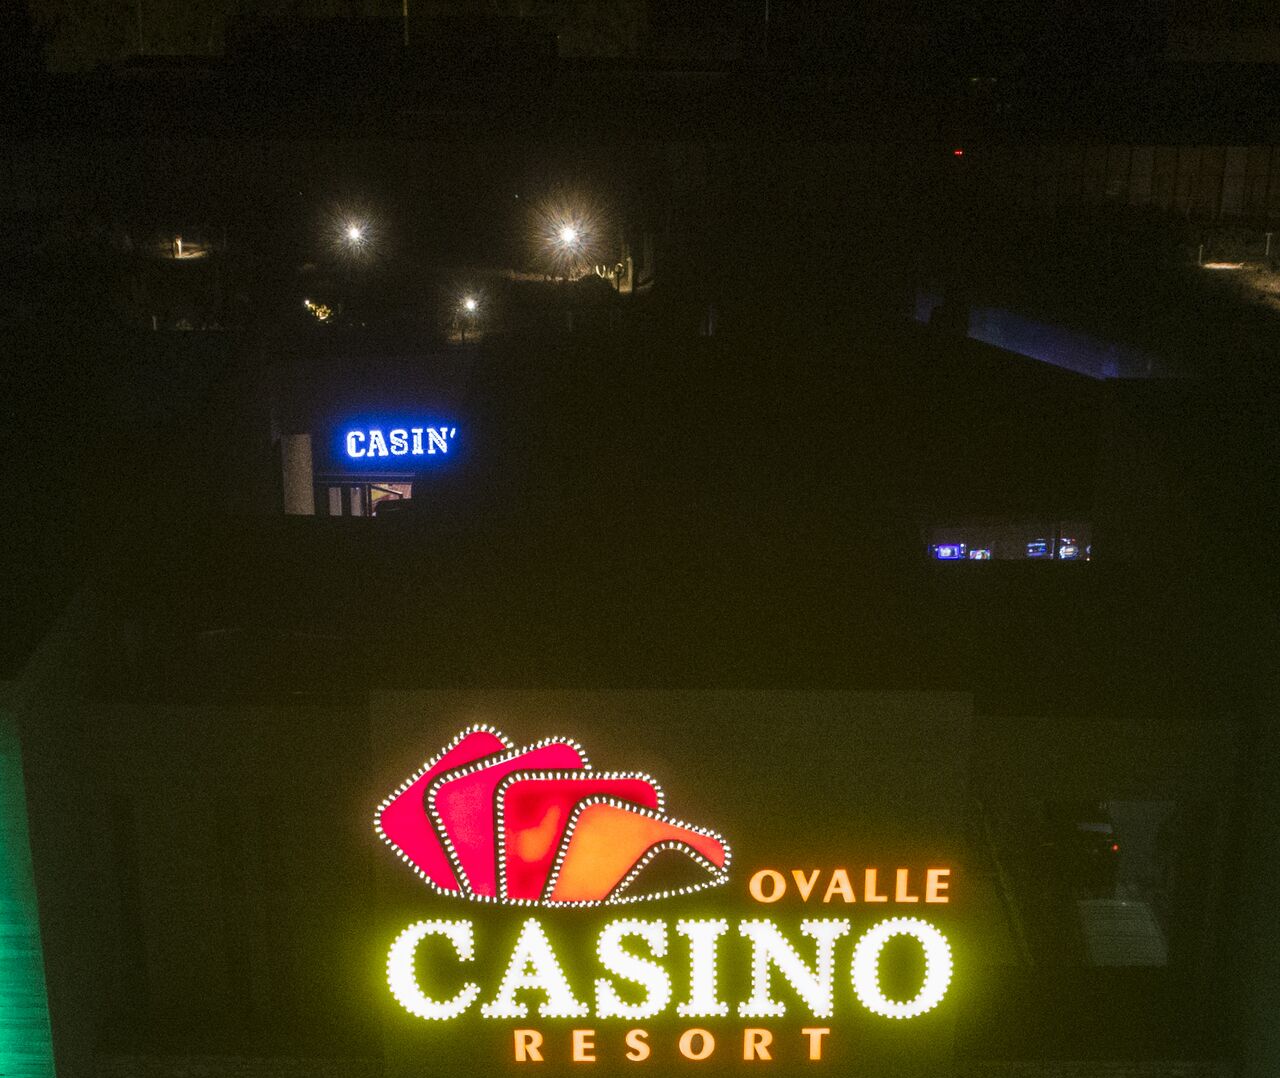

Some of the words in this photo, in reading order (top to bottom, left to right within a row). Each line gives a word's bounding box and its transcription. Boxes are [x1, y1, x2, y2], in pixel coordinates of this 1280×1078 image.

[748, 868, 951, 904] OVALLE
[386, 916, 954, 1021] CASINO
[514, 1027, 831, 1062] RESORT
